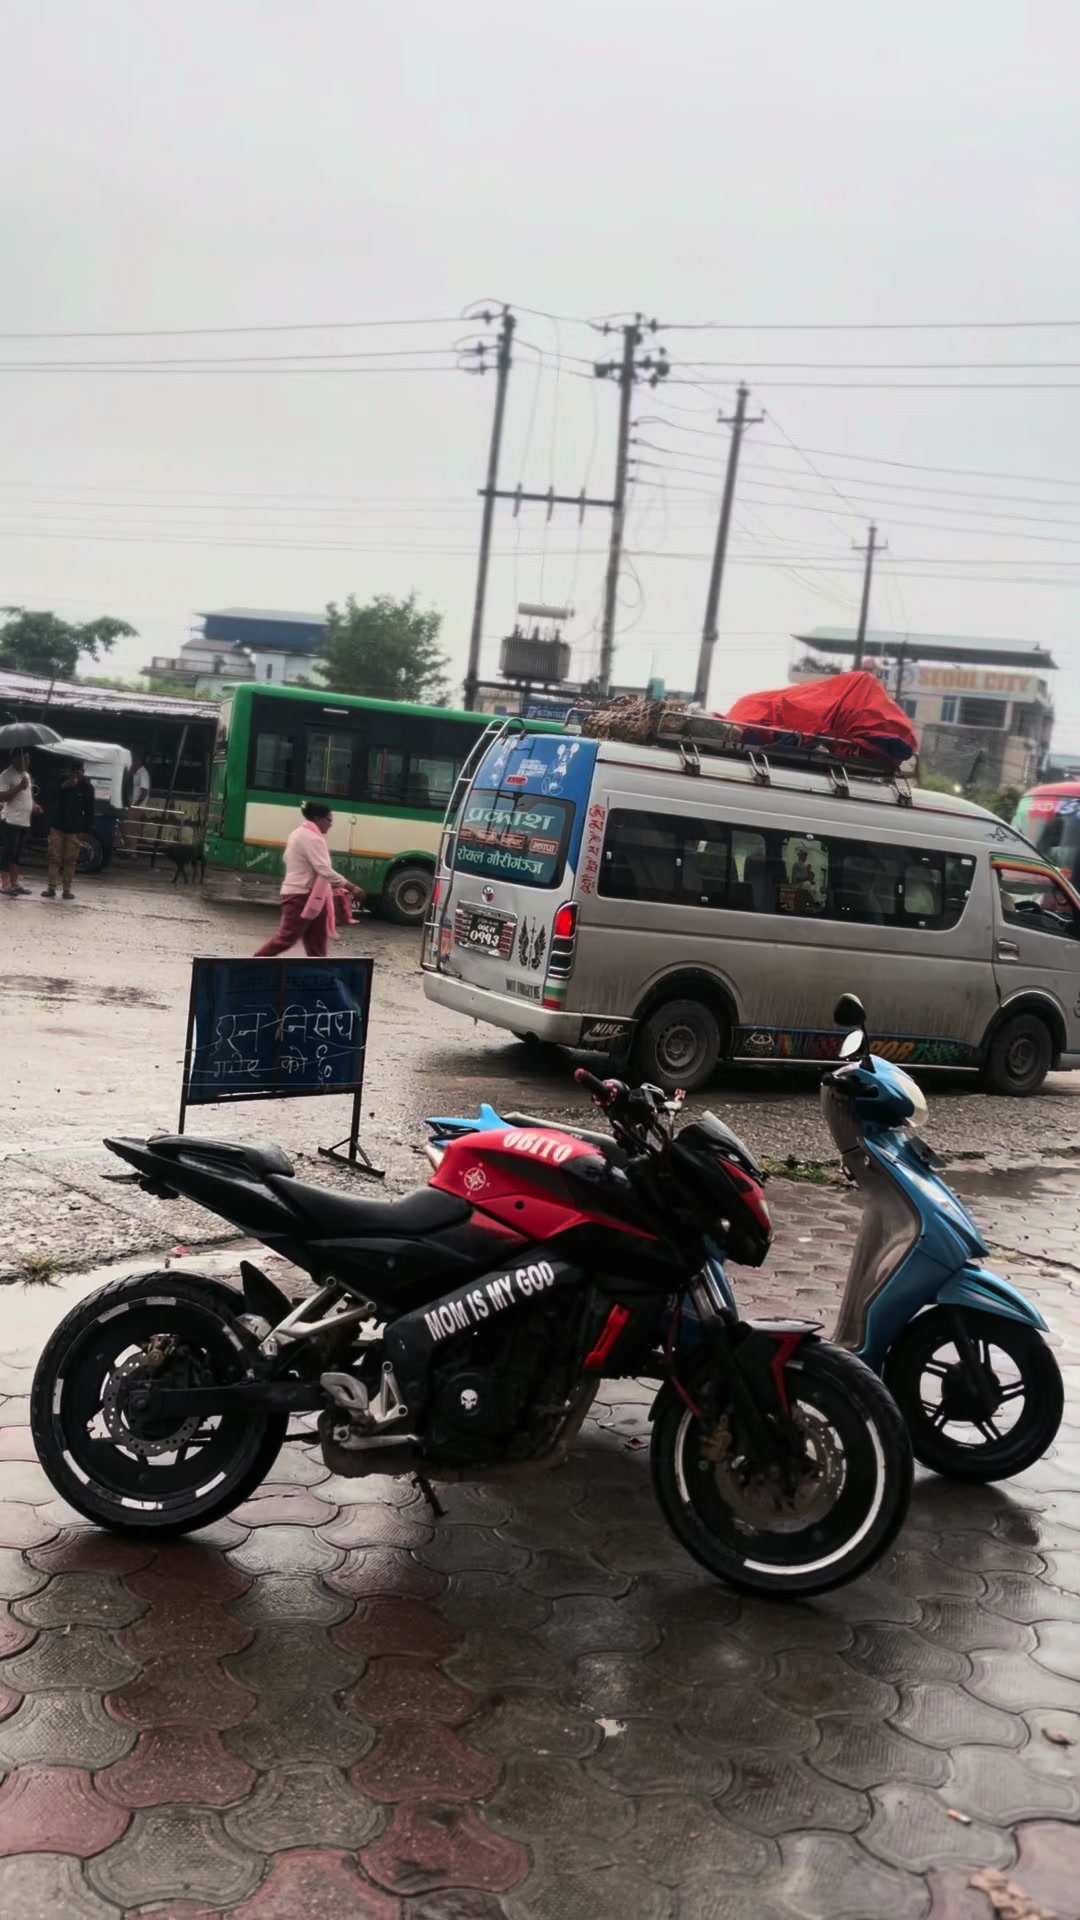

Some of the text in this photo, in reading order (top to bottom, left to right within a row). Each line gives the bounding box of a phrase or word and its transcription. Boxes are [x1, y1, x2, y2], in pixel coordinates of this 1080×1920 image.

[919, 668, 1032, 693] SEOUL CITY
[592, 1022, 624, 1035] NIKE
[503, 1131, 573, 1162] OBITO
[424, 1260, 555, 1341] MOM IS MY GOD
